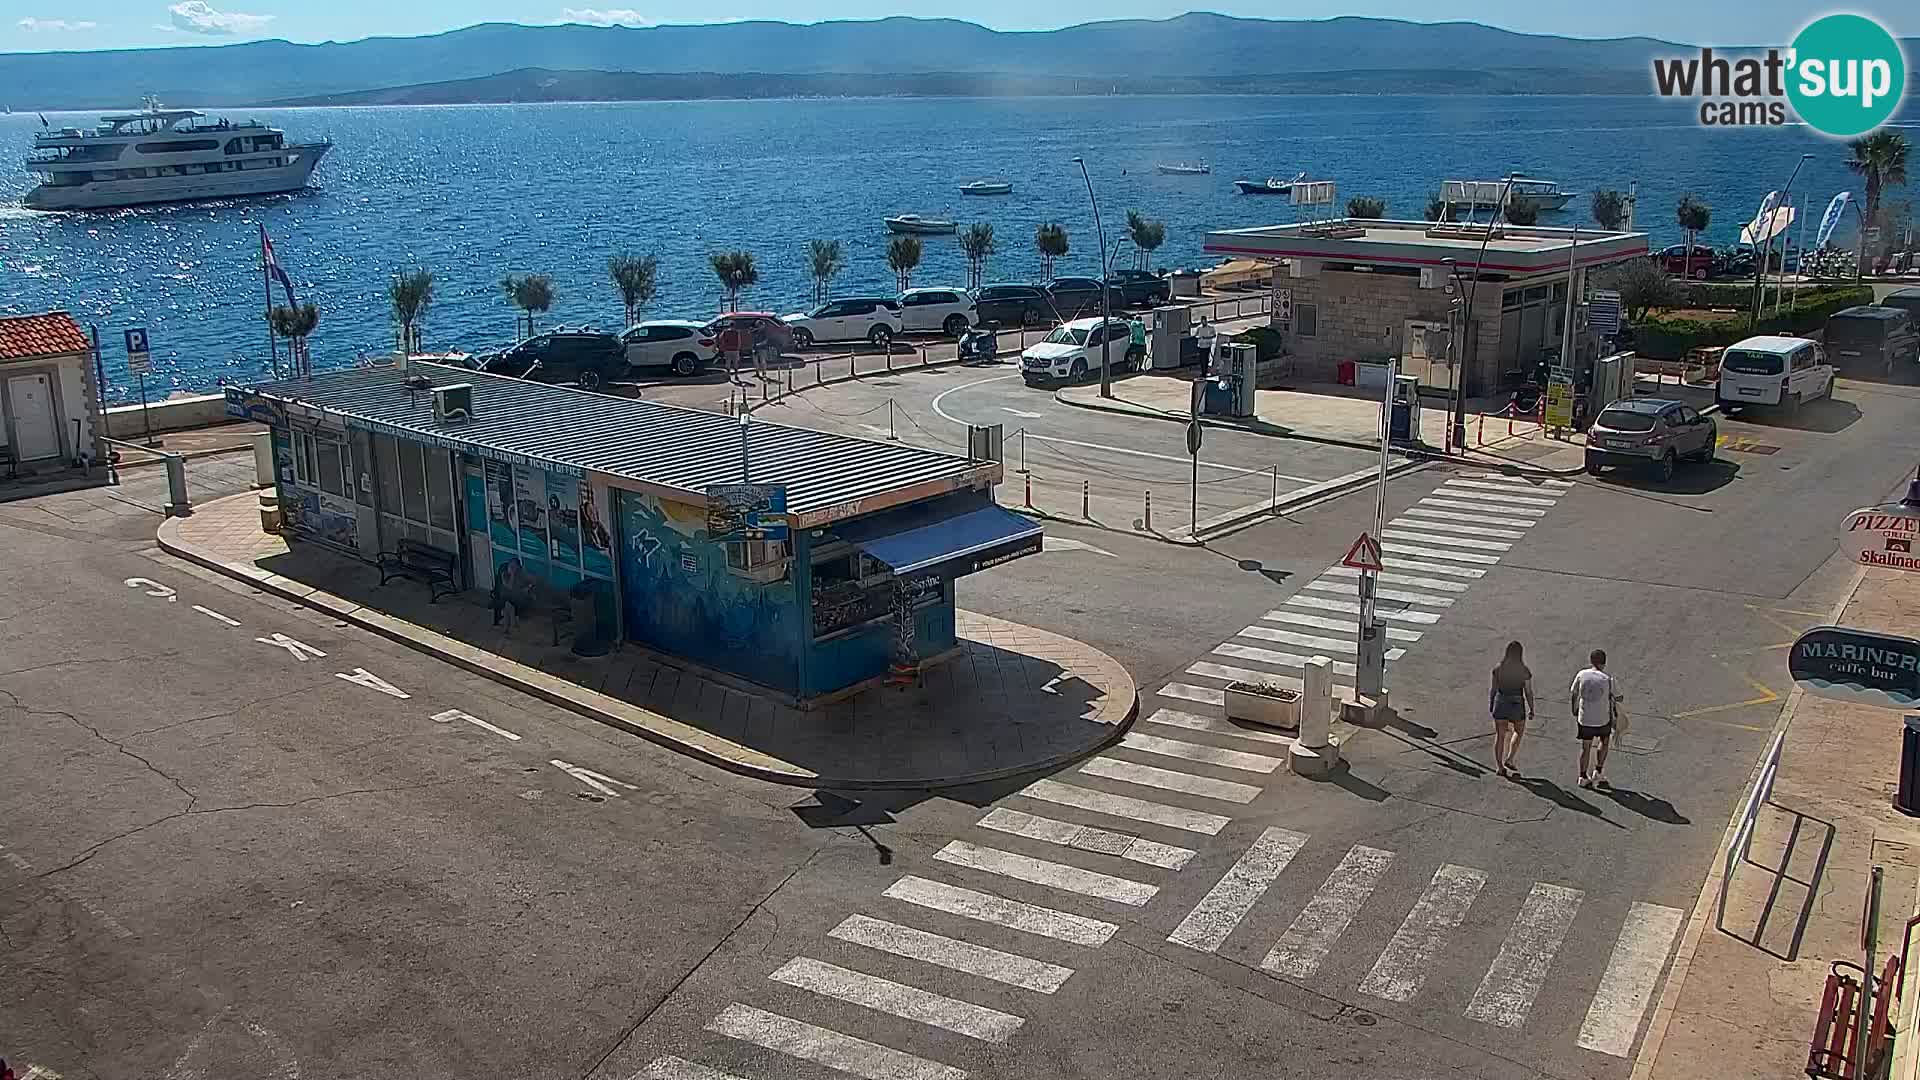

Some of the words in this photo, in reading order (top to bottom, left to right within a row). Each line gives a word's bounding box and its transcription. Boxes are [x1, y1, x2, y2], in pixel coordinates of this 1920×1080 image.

[129, 331, 143, 350] P
[478, 446, 493, 458] BUS
[494, 450, 526, 465] STATION
[528, 457, 555, 472] TICKET
[555, 464, 583, 478] OFFICE
[1848, 515, 1920, 532] PIZZE
[1882, 530, 1919, 541] GRILL
[1801, 643, 1920, 672] MARINER
[1871, 665, 1897, 680] bar
